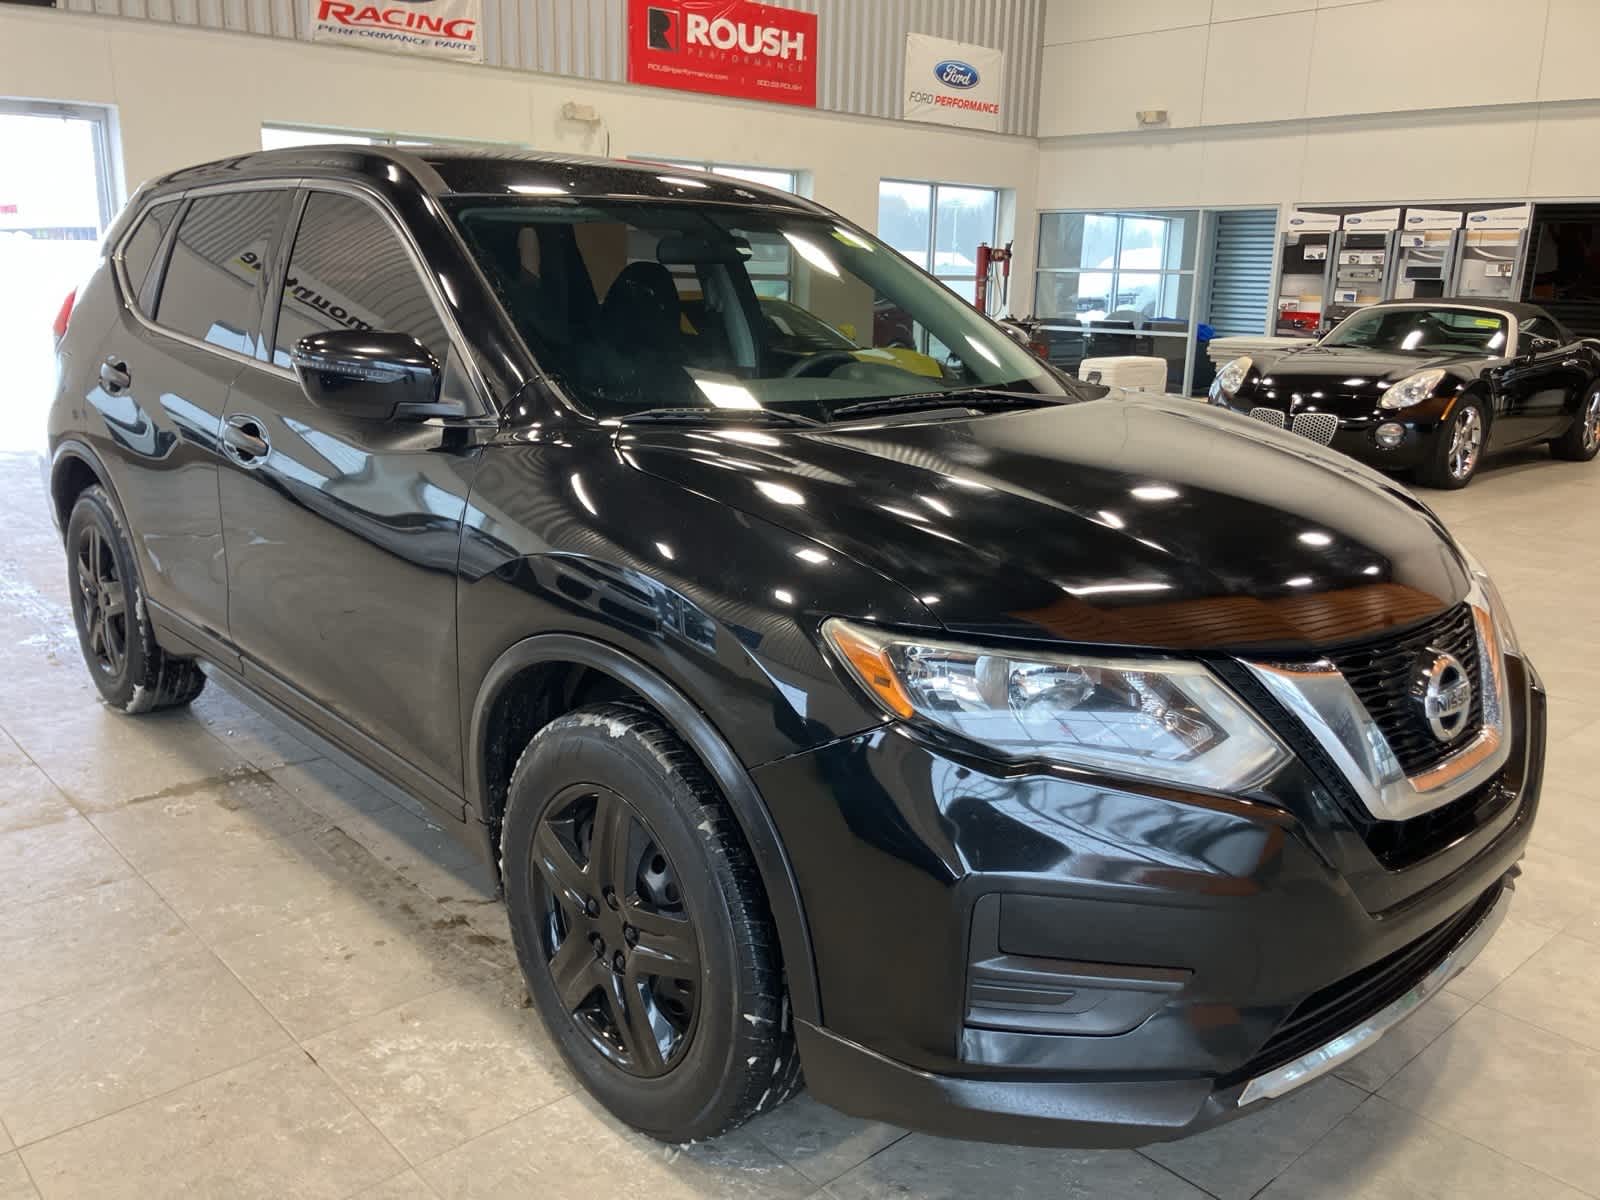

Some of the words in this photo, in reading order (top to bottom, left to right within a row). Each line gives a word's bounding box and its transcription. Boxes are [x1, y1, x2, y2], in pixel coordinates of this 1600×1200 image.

[317, 0, 476, 40] RACING
[318, 24, 430, 46] PERFORMANCE
[434, 40, 477, 51] PARTS
[687, 13, 805, 61] ROUSH
[687, 47, 803, 73] PERFORMANCE
[942, 63, 973, 86] Ford
[908, 90, 934, 105] FORD
[934, 95, 1000, 115] PERFORMANCE
